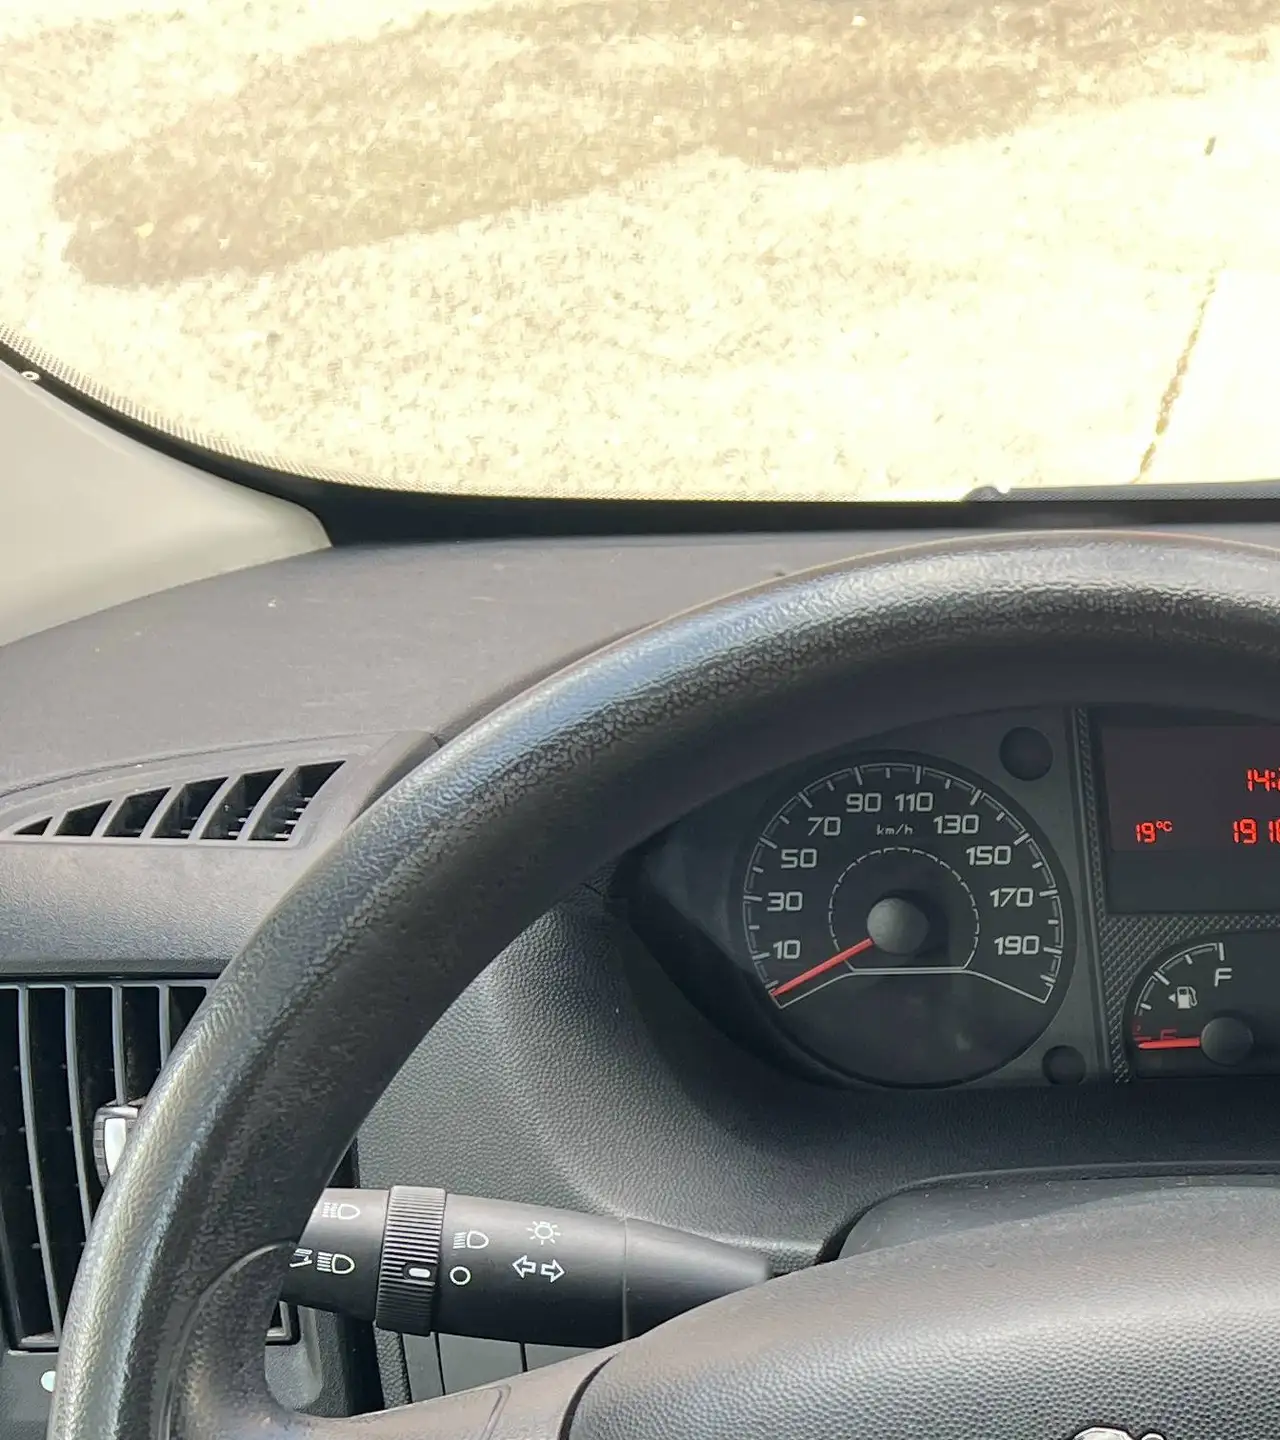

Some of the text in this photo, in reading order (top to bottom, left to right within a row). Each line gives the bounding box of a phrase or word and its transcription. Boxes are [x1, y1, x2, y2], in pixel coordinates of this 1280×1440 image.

[845, 793, 882, 812] 90
[894, 792, 933, 811] 110
[807, 816, 841, 837] 70
[876, 823, 913, 836] km/h
[932, 815, 980, 834] 130
[780, 848, 817, 868] 50
[965, 845, 1011, 865] 150
[766, 891, 802, 911] 30
[989, 887, 1034, 907] 170
[771, 940, 801, 960] 10
[993, 936, 1040, 956] 190
[1214, 967, 1232, 987] F
